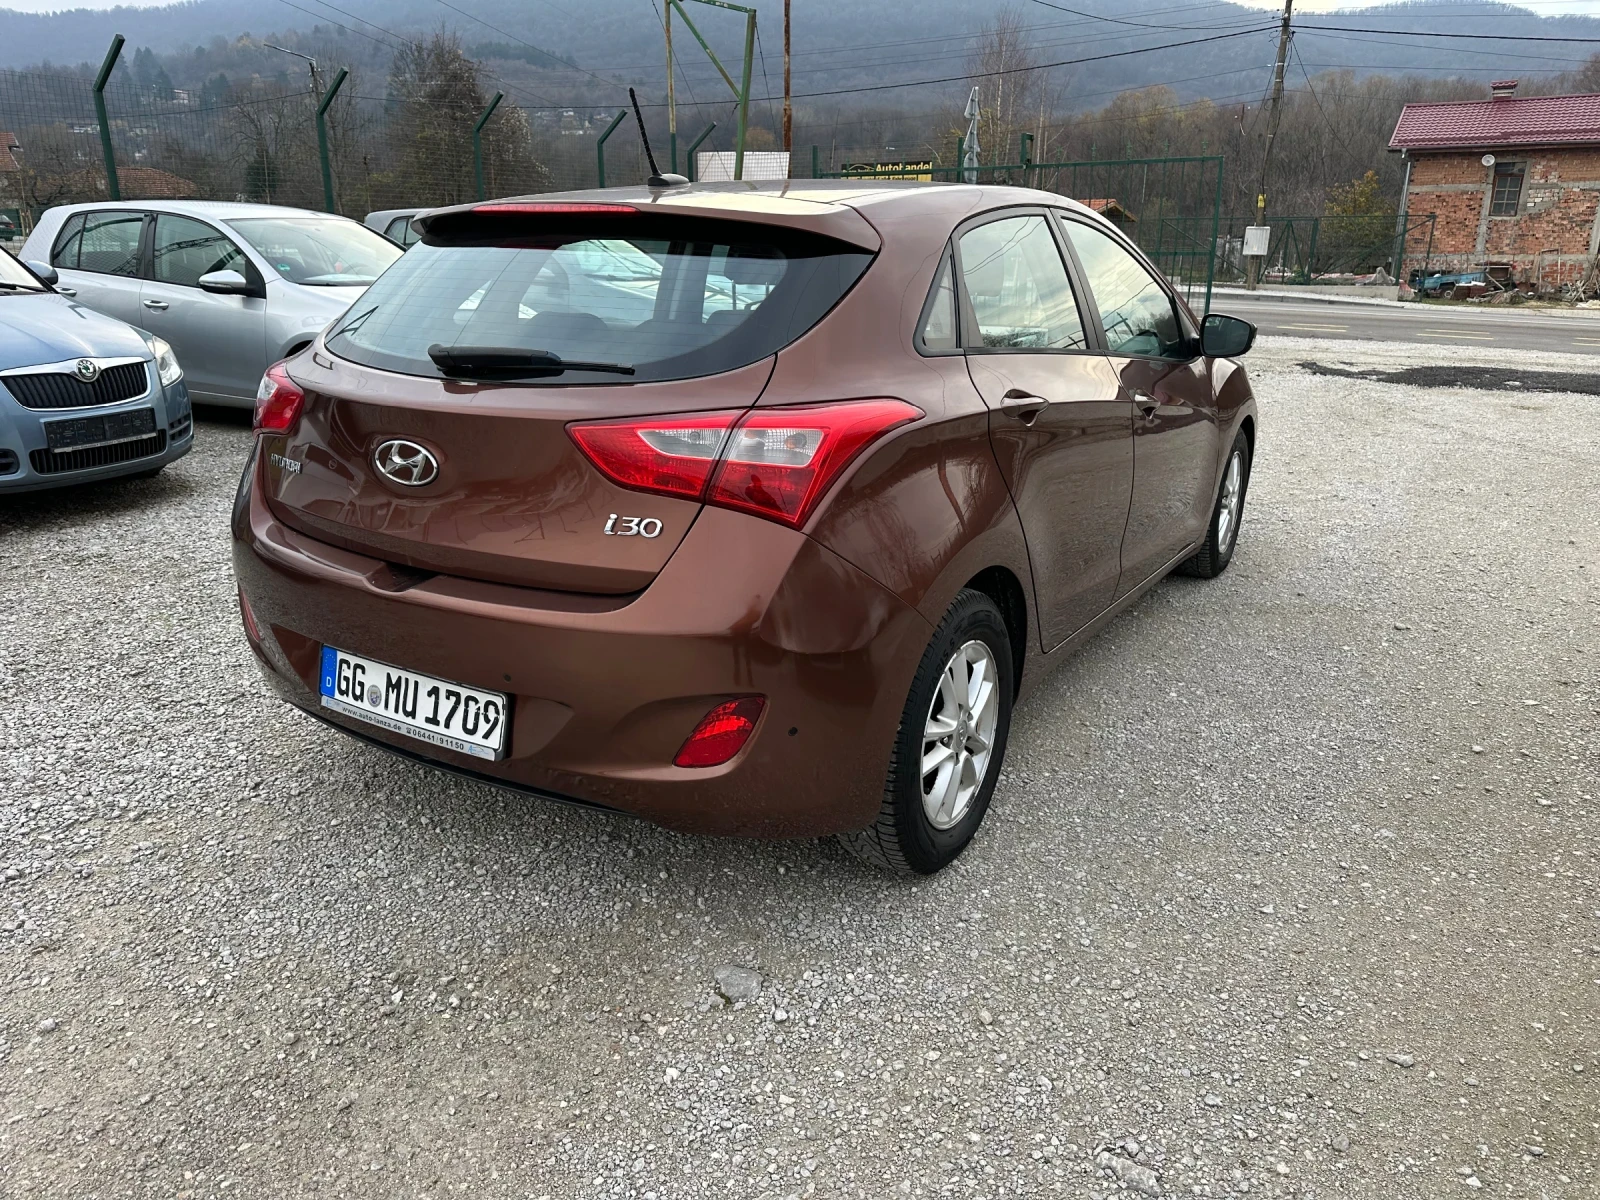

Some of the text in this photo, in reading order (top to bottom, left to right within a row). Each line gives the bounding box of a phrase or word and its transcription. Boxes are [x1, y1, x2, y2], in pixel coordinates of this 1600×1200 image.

[603, 513, 663, 538] i30
[326, 676, 332, 687] D
[337, 658, 500, 740] GG MU 1709
[342, 706, 402, 731] www.auto-lanza.de
